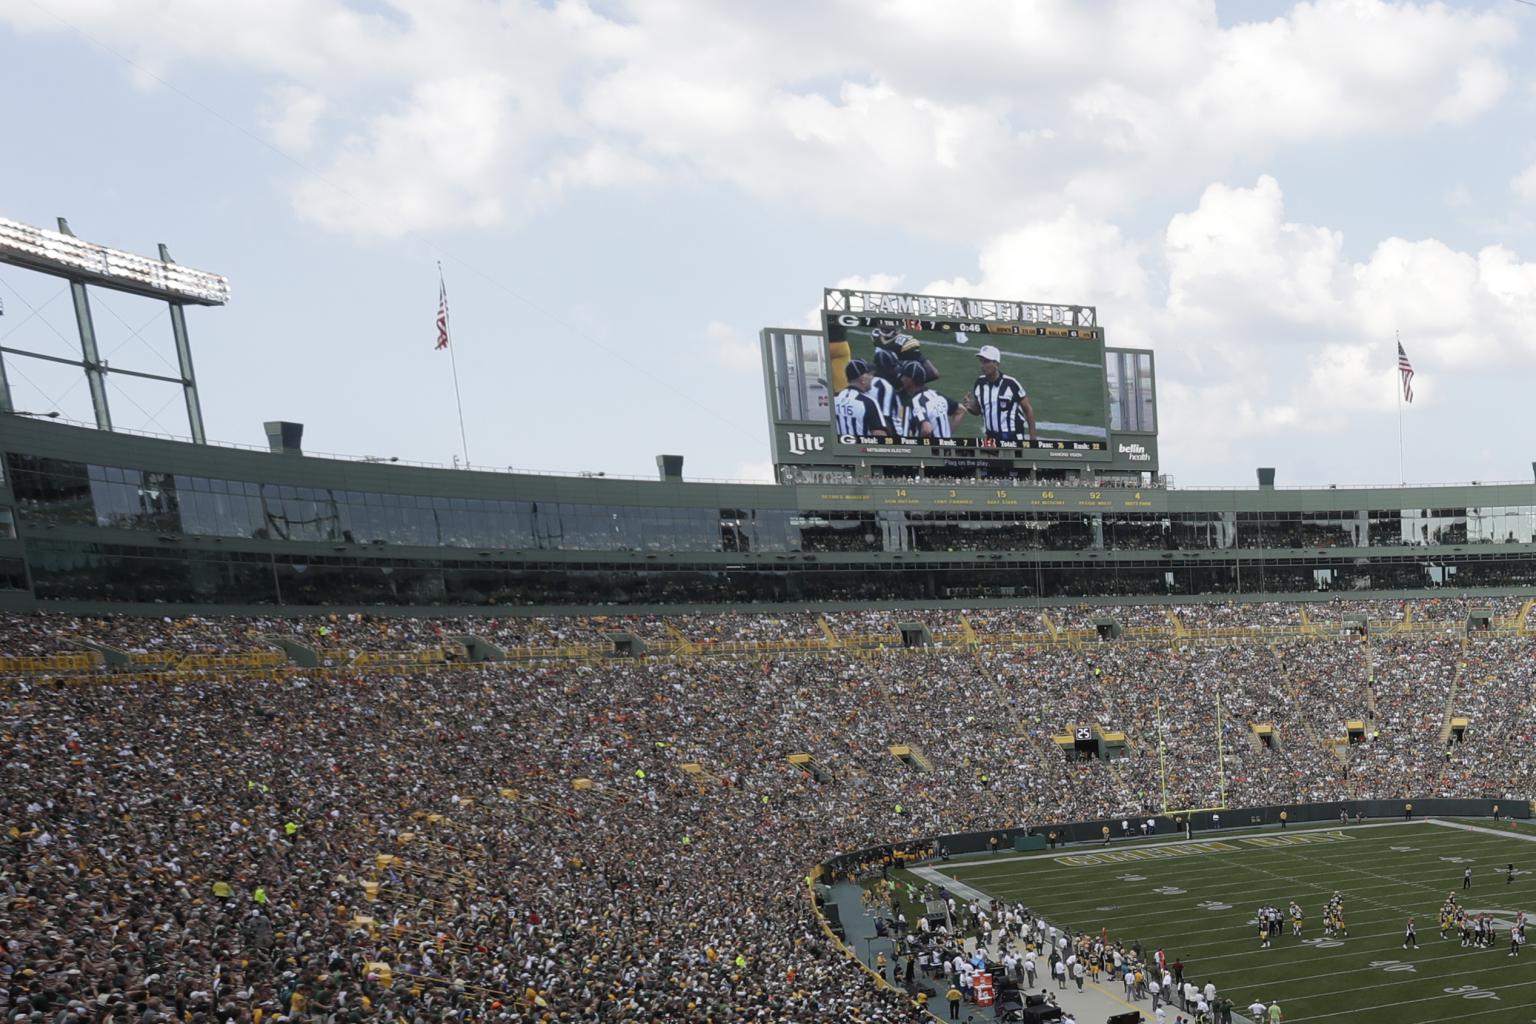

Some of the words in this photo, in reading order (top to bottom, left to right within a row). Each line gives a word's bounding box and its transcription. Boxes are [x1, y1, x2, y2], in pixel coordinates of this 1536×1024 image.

[863, 293, 983, 319] LAMBEAU
[995, 301, 1065, 323] FIELD
[959, 323, 980, 333] 0:46
[787, 431, 824, 456] Lite
[860, 436, 878, 445] Total:
[1000, 440, 1017, 449] Total:
[1119, 443, 1145, 454] bellin
[1129, 453, 1151, 461] health
[944, 459, 957, 467] Flag
[895, 489, 907, 497] 14
[948, 489, 956, 498] 3
[996, 490, 1008, 498] 15
[1041, 491, 1054, 499] 66
[1089, 491, 1101, 500] 92
[1134, 491, 1141, 500] 4
[1053, 842, 1242, 867] GREEN
[1369, 960, 1414, 973] 40
[1443, 985, 1497, 1000] 30
